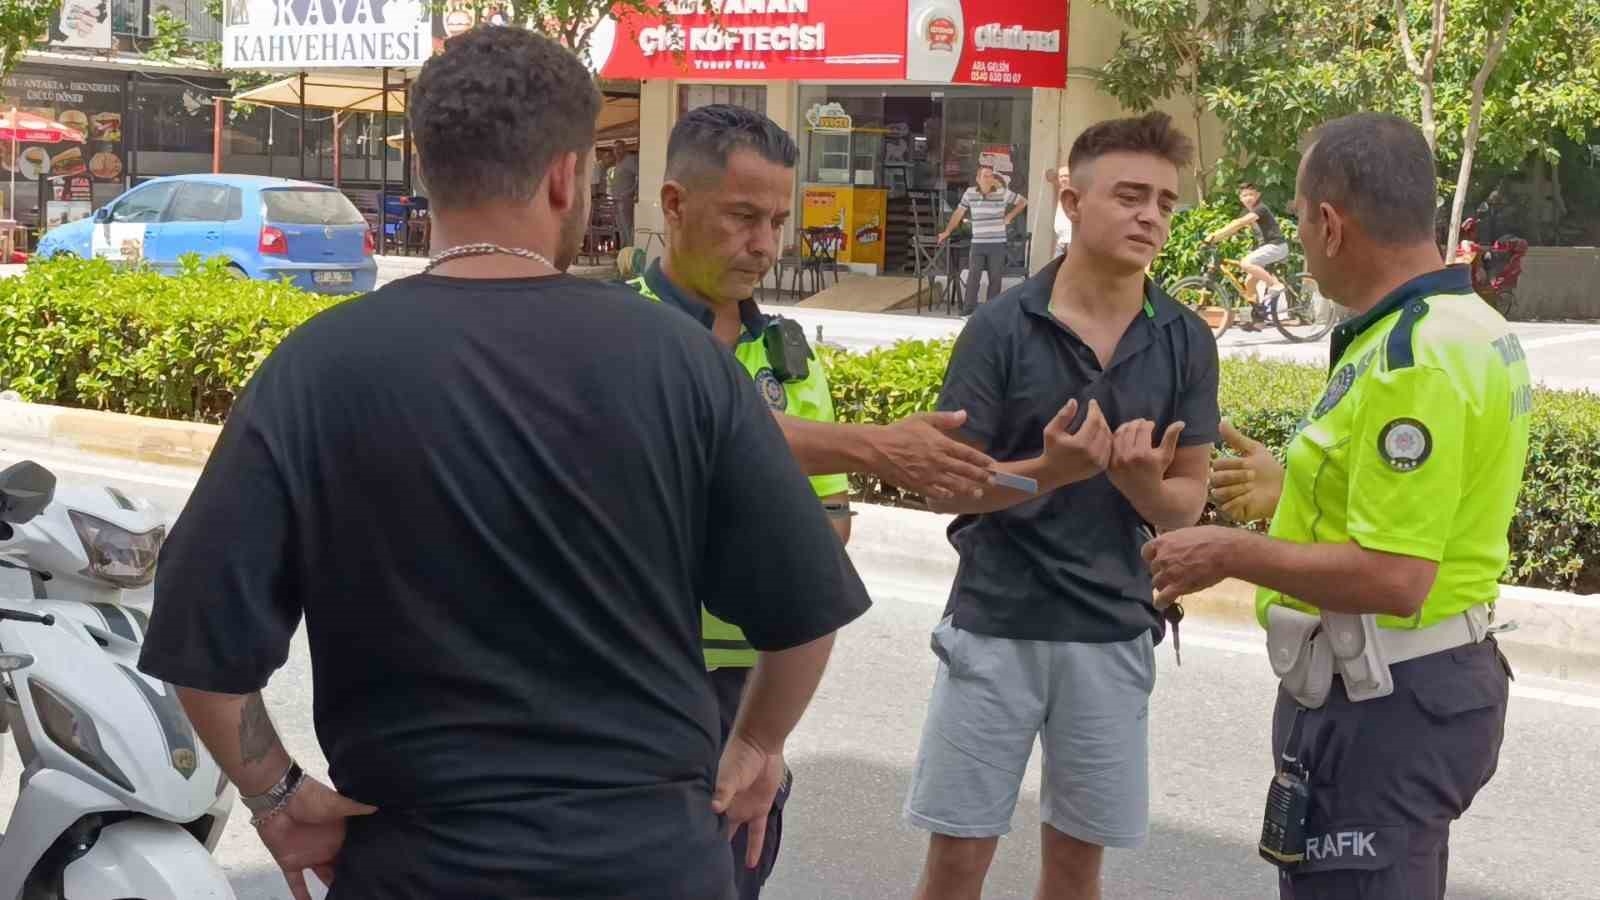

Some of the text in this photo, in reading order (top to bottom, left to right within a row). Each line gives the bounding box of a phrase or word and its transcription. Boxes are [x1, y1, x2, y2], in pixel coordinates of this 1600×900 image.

[275, 0, 379, 26] KAYA
[234, 25, 420, 62] KAHVEHANESİ
[689, 22, 825, 51] KÖFTECİSİ
